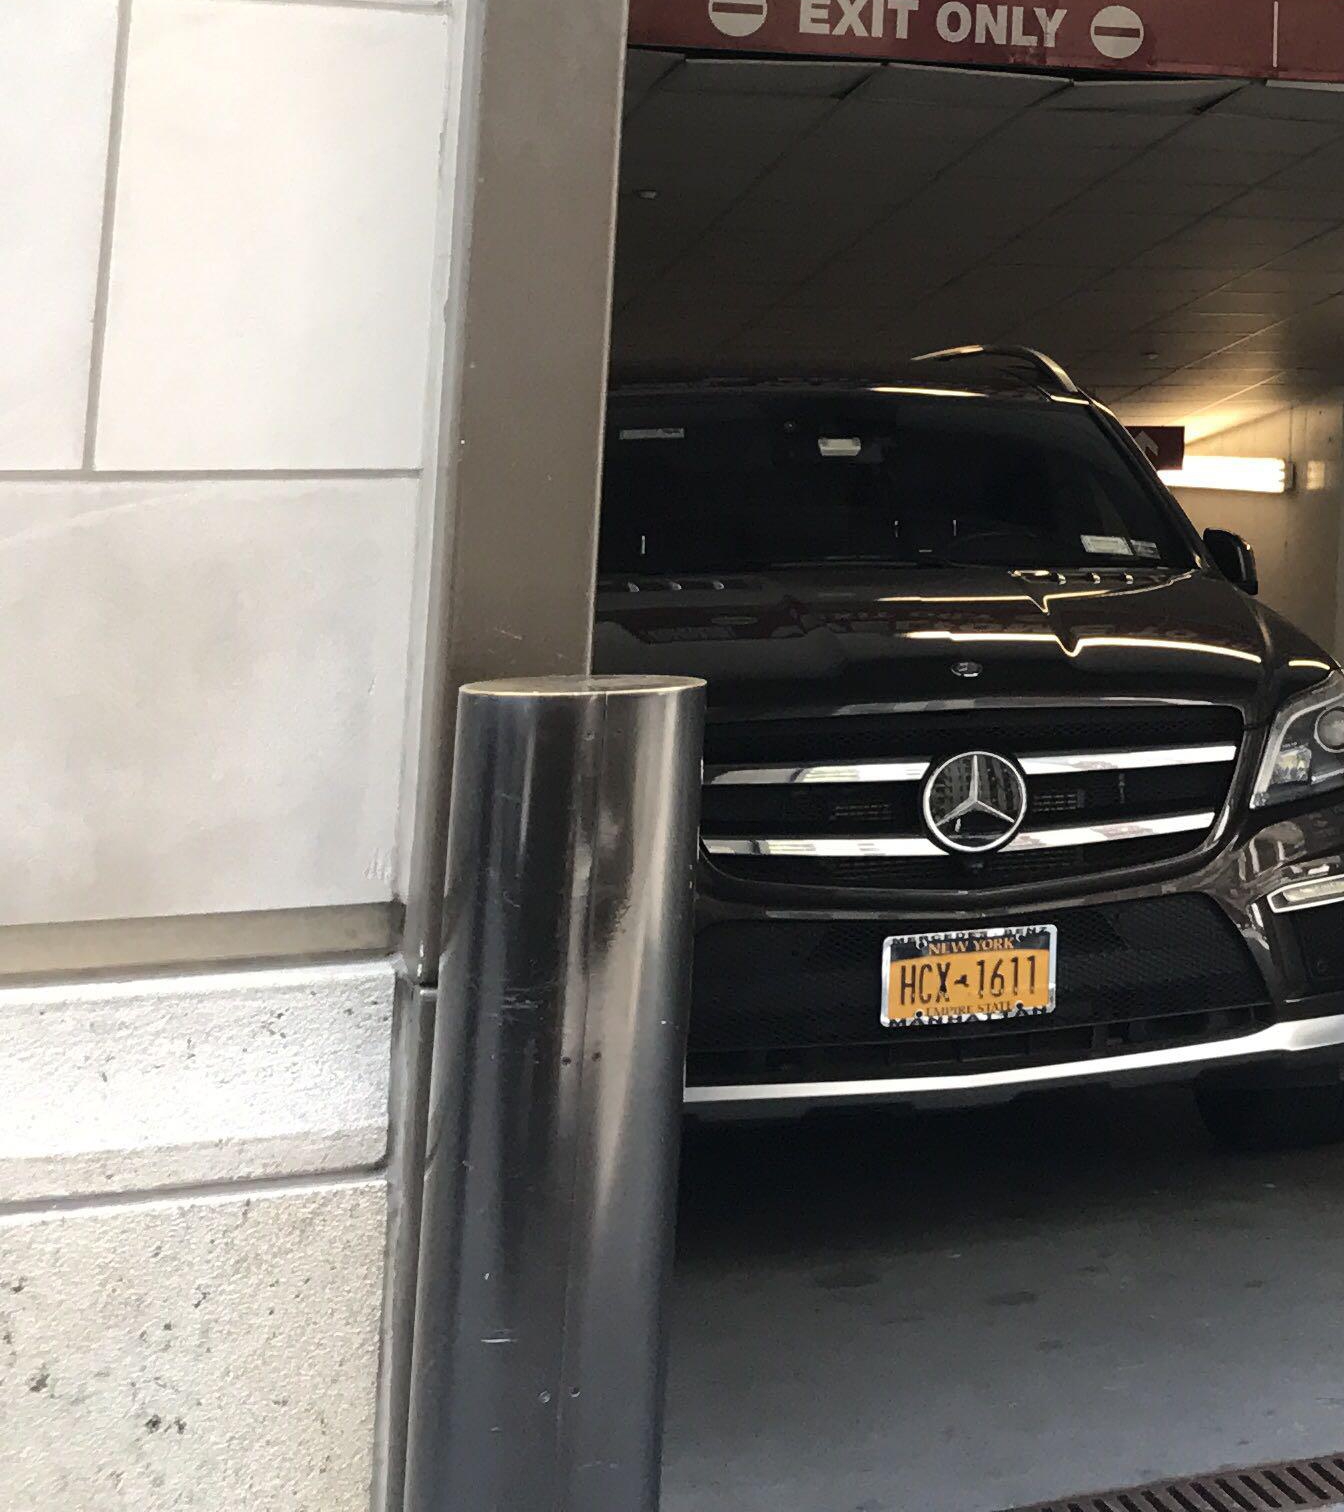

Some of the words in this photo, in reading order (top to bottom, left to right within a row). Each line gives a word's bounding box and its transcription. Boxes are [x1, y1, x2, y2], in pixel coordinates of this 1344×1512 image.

[936, 1, 1067, 48] ONLY
[928, 941, 969, 956] NEW
[974, 938, 1015, 951] YORK
